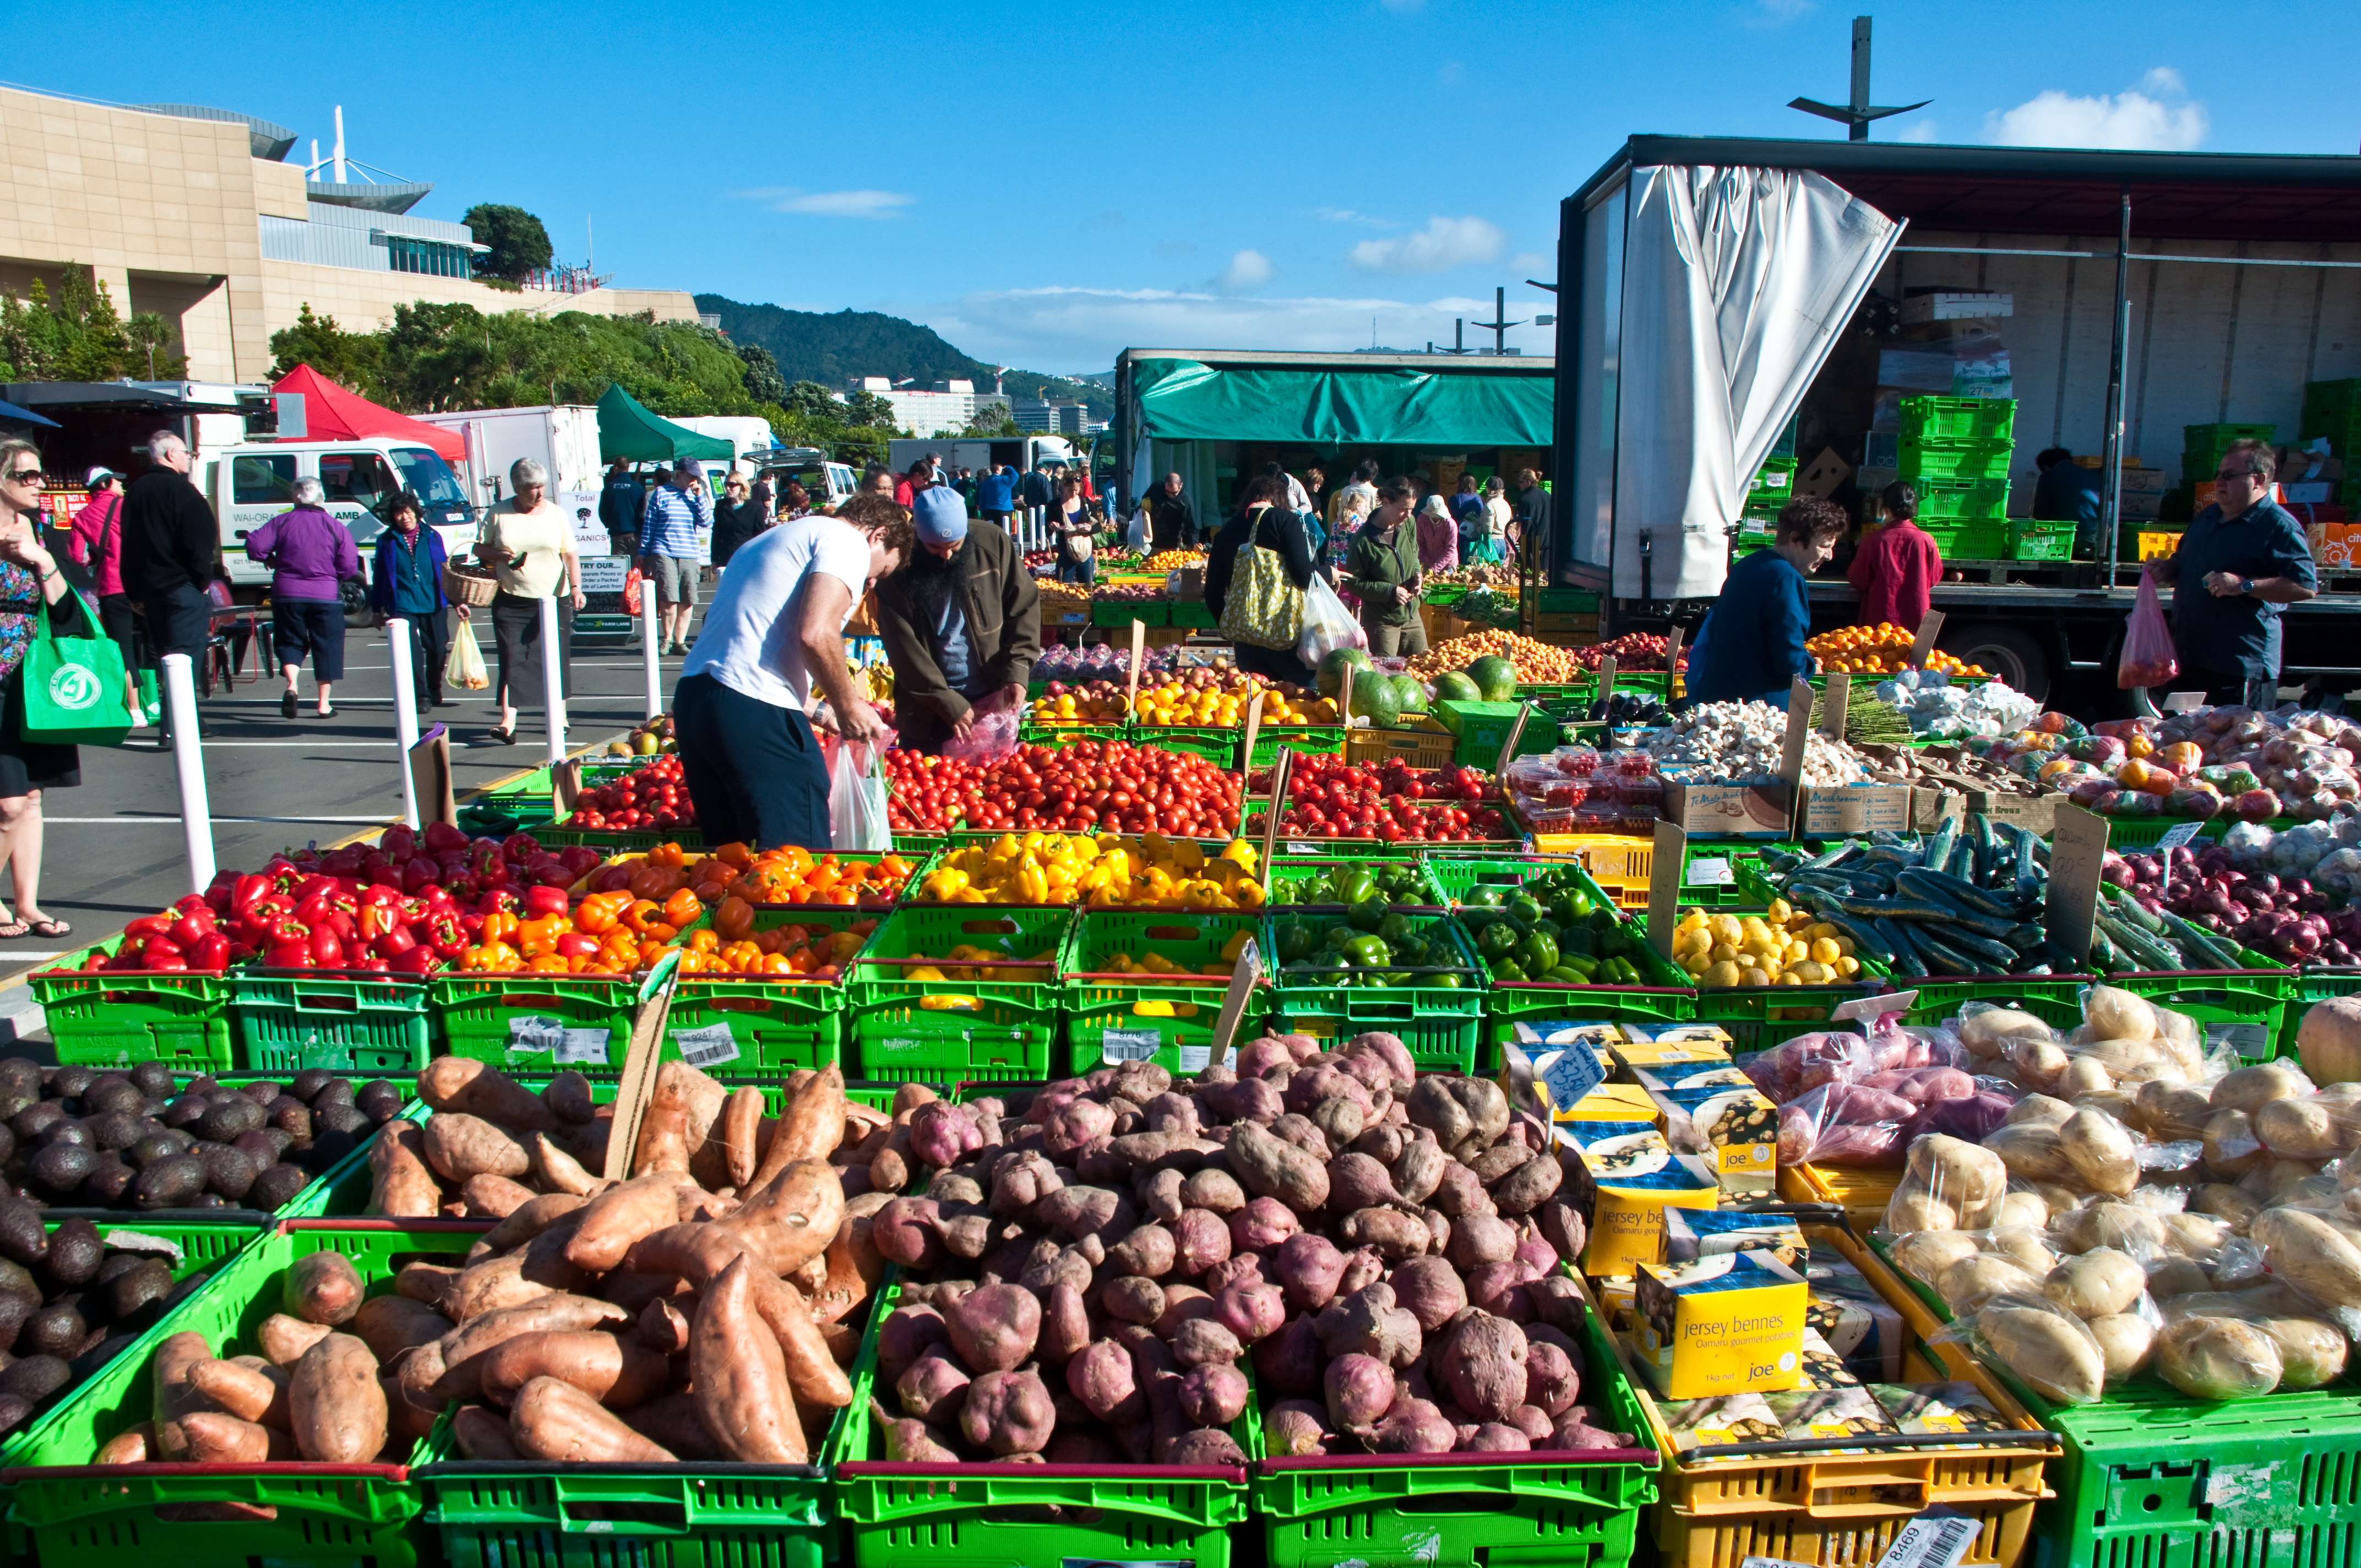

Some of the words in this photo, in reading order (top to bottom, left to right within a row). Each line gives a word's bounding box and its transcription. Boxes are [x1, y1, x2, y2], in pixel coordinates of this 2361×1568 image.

[1970, 386, 1982, 396] 27
[445, 513, 465, 522] ISUZU
[1810, 790, 1862, 802] Mushrooms
[1995, 805, 2020, 814] Brown
[76, 1036, 121, 1046] LABEL
[692, 1030, 712, 1042] 9247
[1725, 1152, 1746, 1168] joe
[1602, 1207, 1643, 1227] jersey
[1613, 1226, 1642, 1234] Oamaru
[1684, 1319, 1728, 1340] jersey
[1733, 1315, 1783, 1332] bennes
[1696, 1339, 1728, 1348] Oamaru
[1731, 1336, 1762, 1347] gourmet
[1765, 1331, 1794, 1343] potatoes
[1747, 1363, 1774, 1382] joe
[1930, 1422, 1951, 1432] jo
[1819, 1430, 1840, 1438] jo
[1890, 1527, 1919, 1561] 8469
